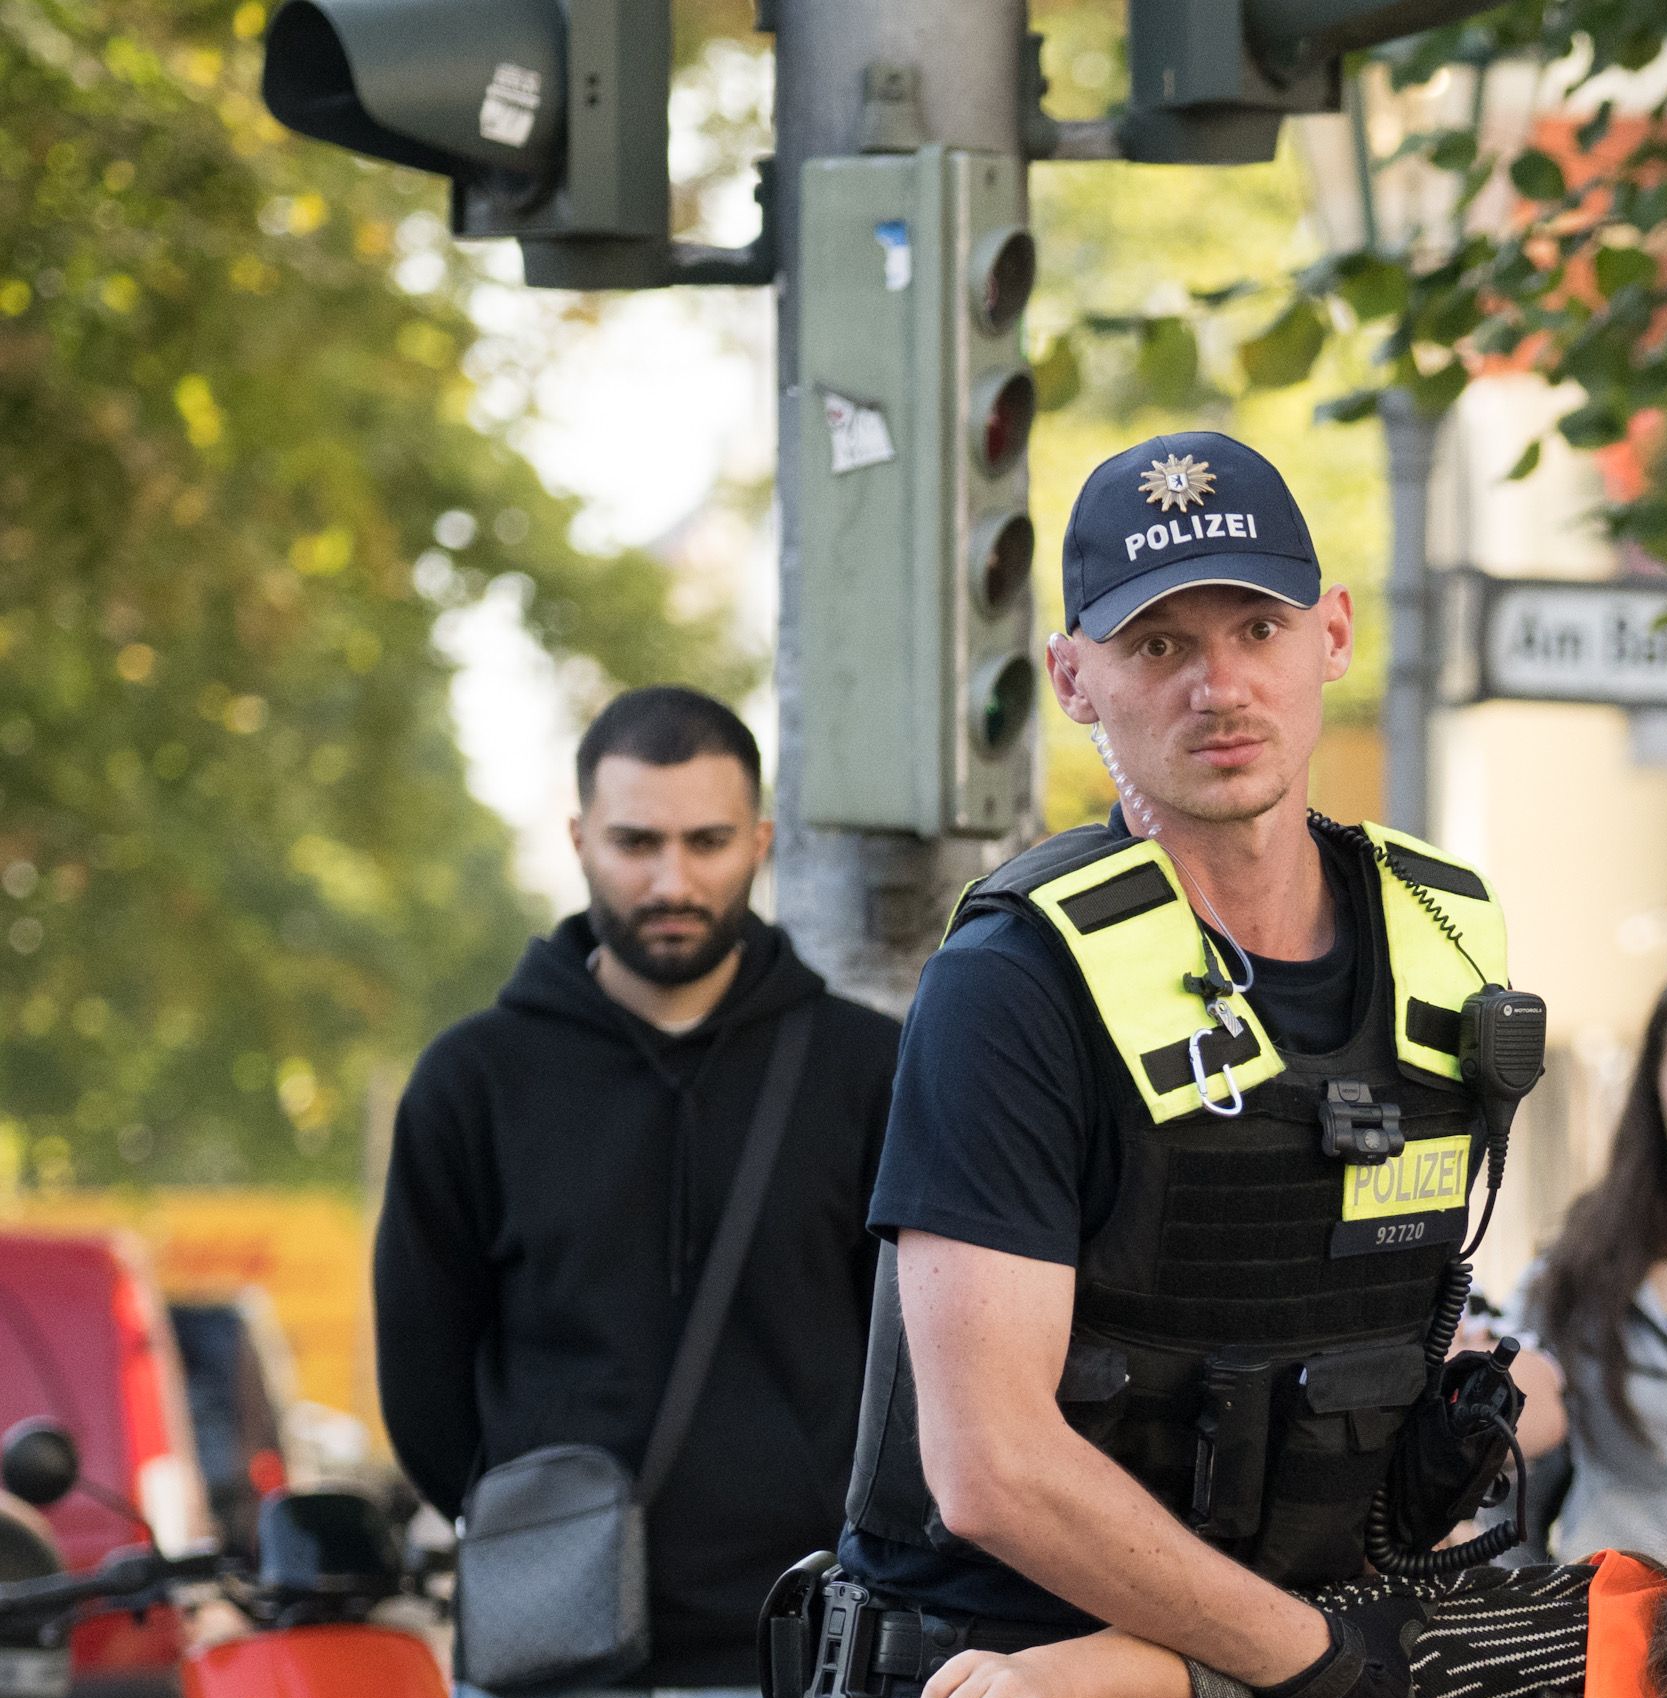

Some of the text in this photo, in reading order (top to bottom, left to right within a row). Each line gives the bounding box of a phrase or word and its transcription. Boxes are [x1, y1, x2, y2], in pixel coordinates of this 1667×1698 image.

[1124, 513, 1258, 562] POLIZEI
[1353, 1149, 1465, 1207] POLIZEI
[1376, 1221, 1425, 1246] 92720
